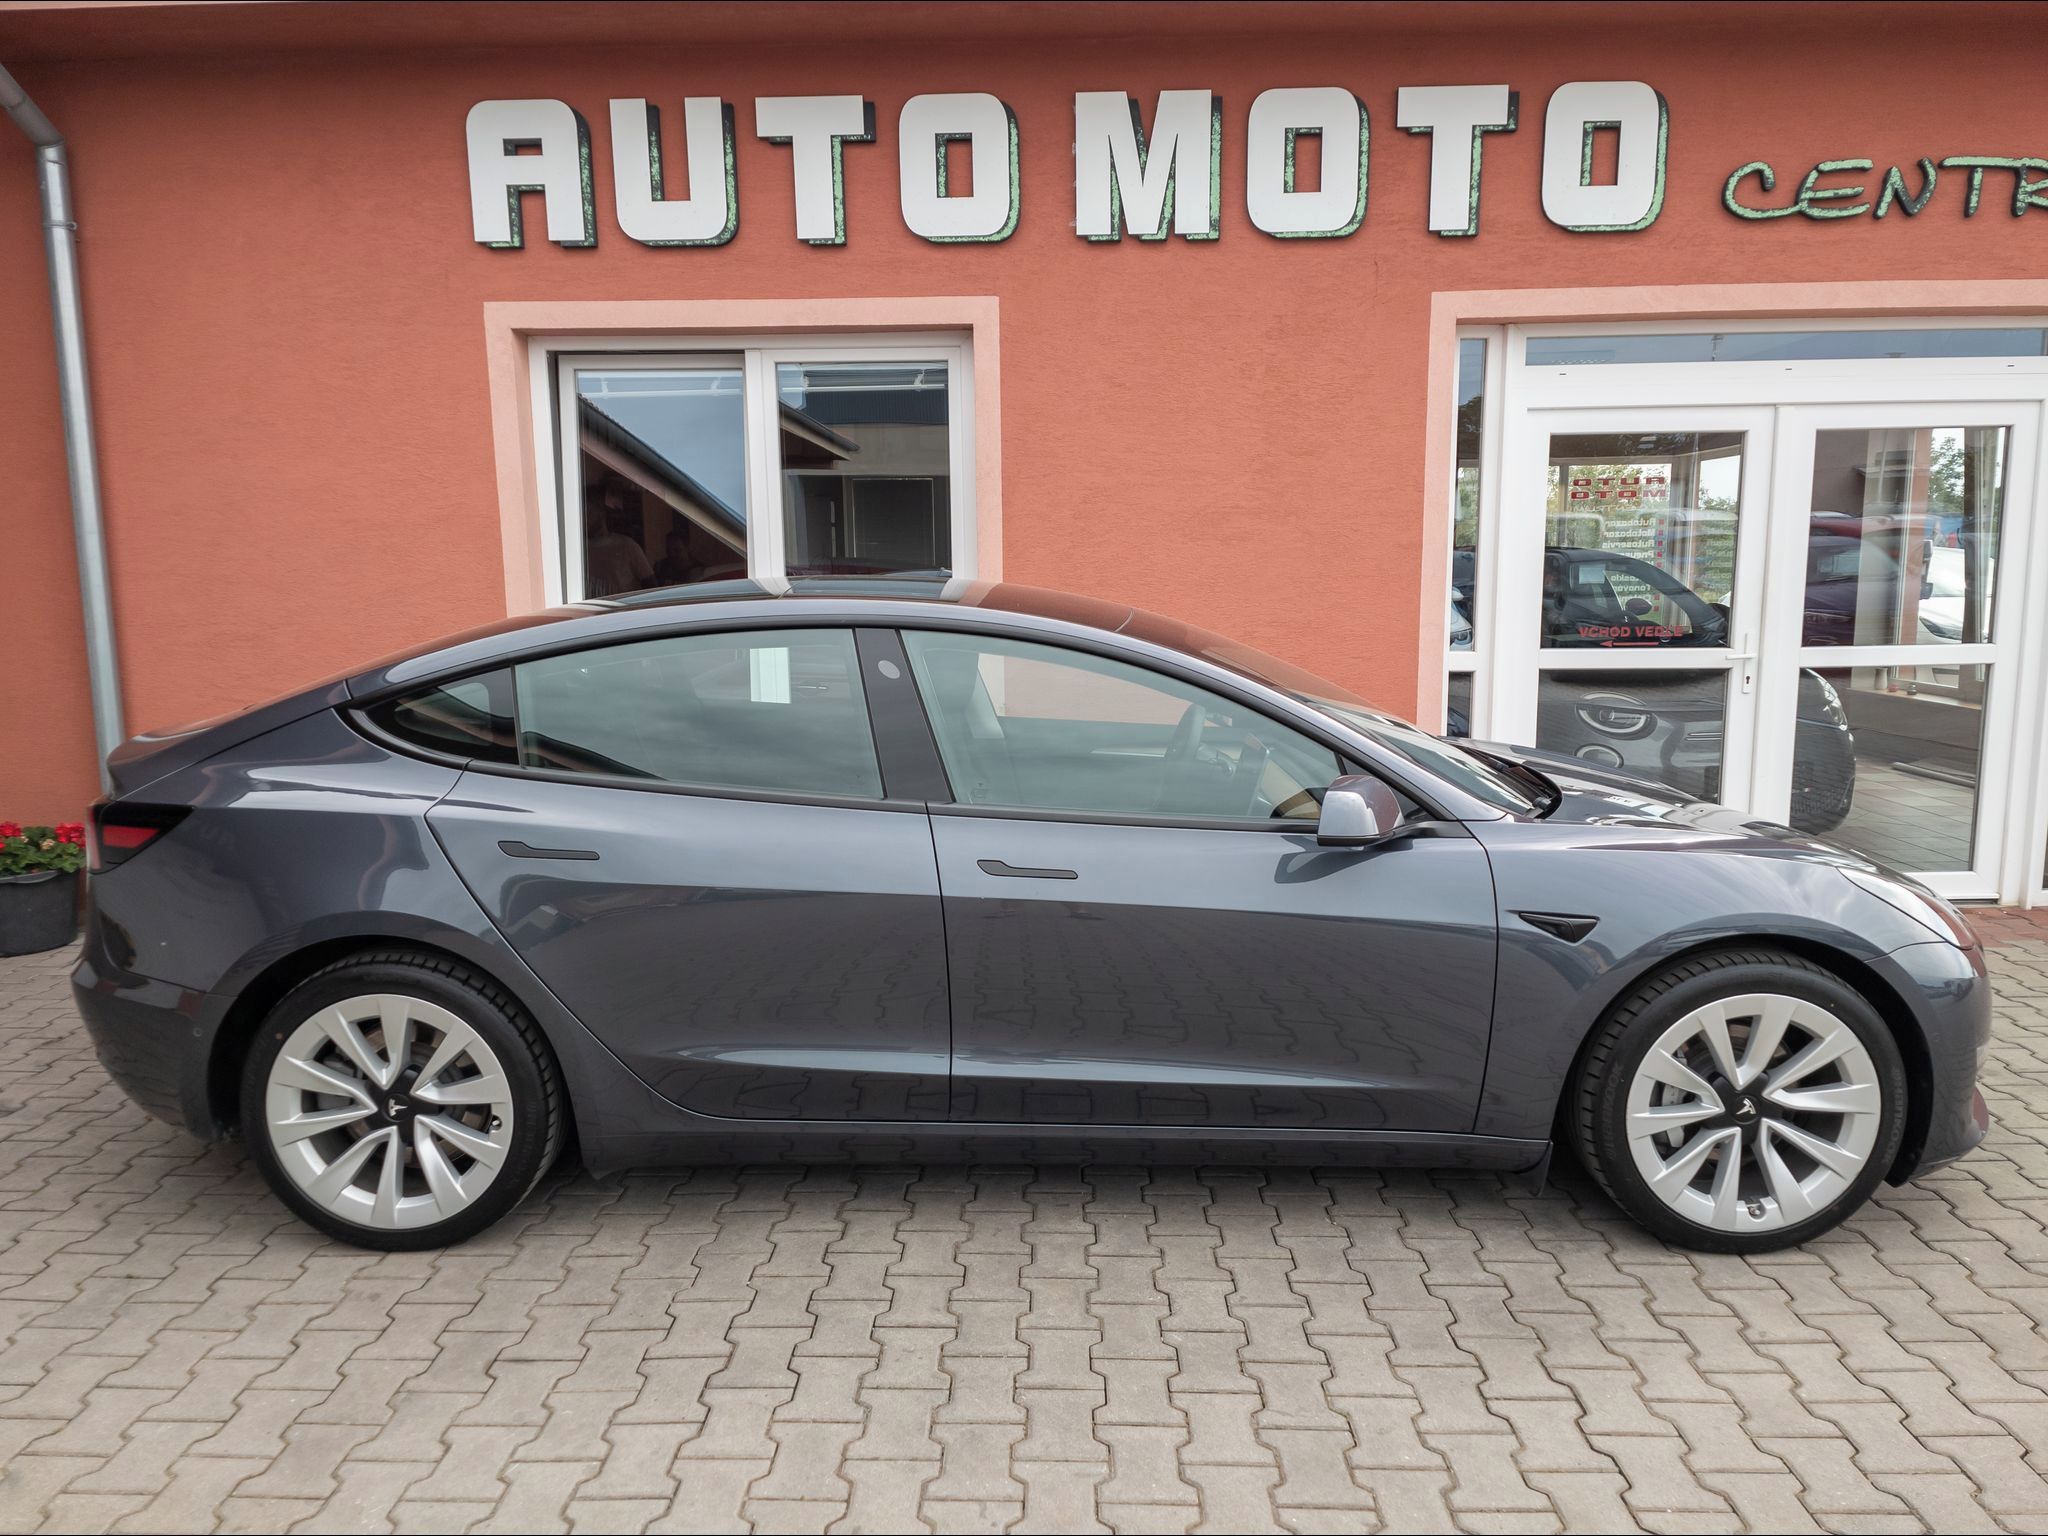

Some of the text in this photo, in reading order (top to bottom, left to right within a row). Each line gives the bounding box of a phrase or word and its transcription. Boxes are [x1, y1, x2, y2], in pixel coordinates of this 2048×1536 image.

[465, 92, 1020, 248] AUTO
[1074, 80, 1670, 242] MOTO
[1578, 625, 1685, 638] VCHOD VEDLE
